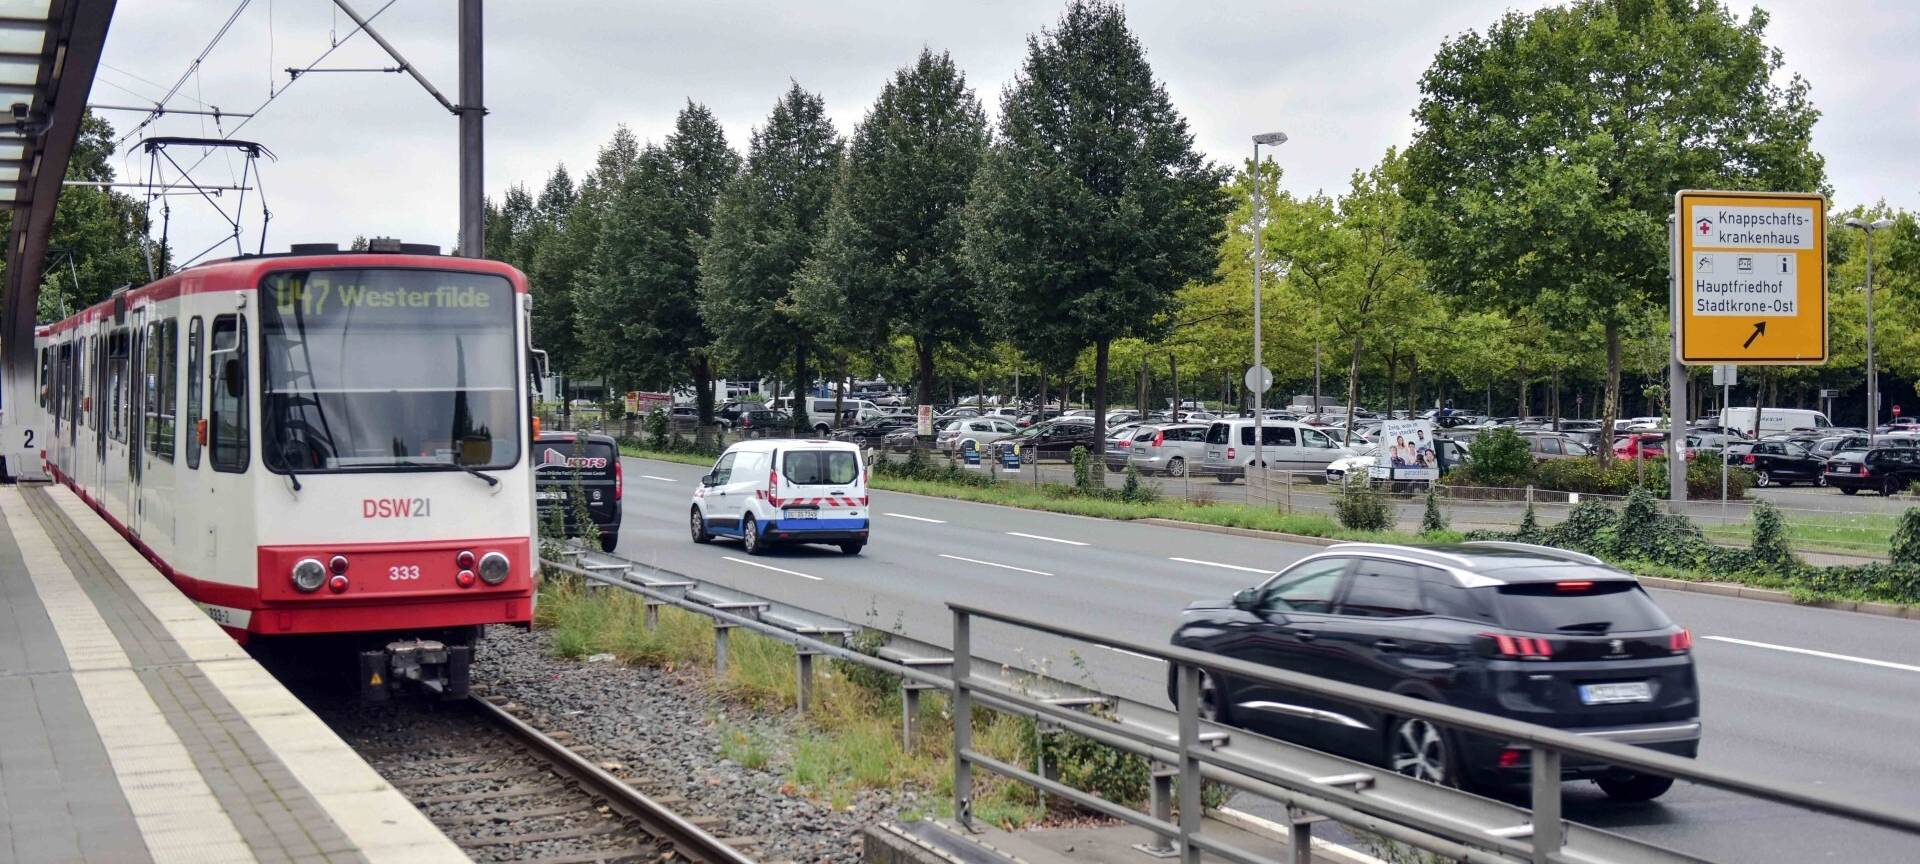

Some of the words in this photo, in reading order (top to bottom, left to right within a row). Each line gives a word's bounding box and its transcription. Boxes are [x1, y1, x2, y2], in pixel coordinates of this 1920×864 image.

[1719, 211, 1809, 228] Knappschafts-
[1719, 230, 1800, 245] krankenhaus
[1696, 280, 1783, 296] Hauptfriedhof
[276, 279, 330, 315] U47
[338, 284, 490, 308] Westerfilde
[1697, 298, 1793, 313] Stadtkrone-Ost
[24, 429, 34, 448] 2
[389, 565, 420, 581] 333
